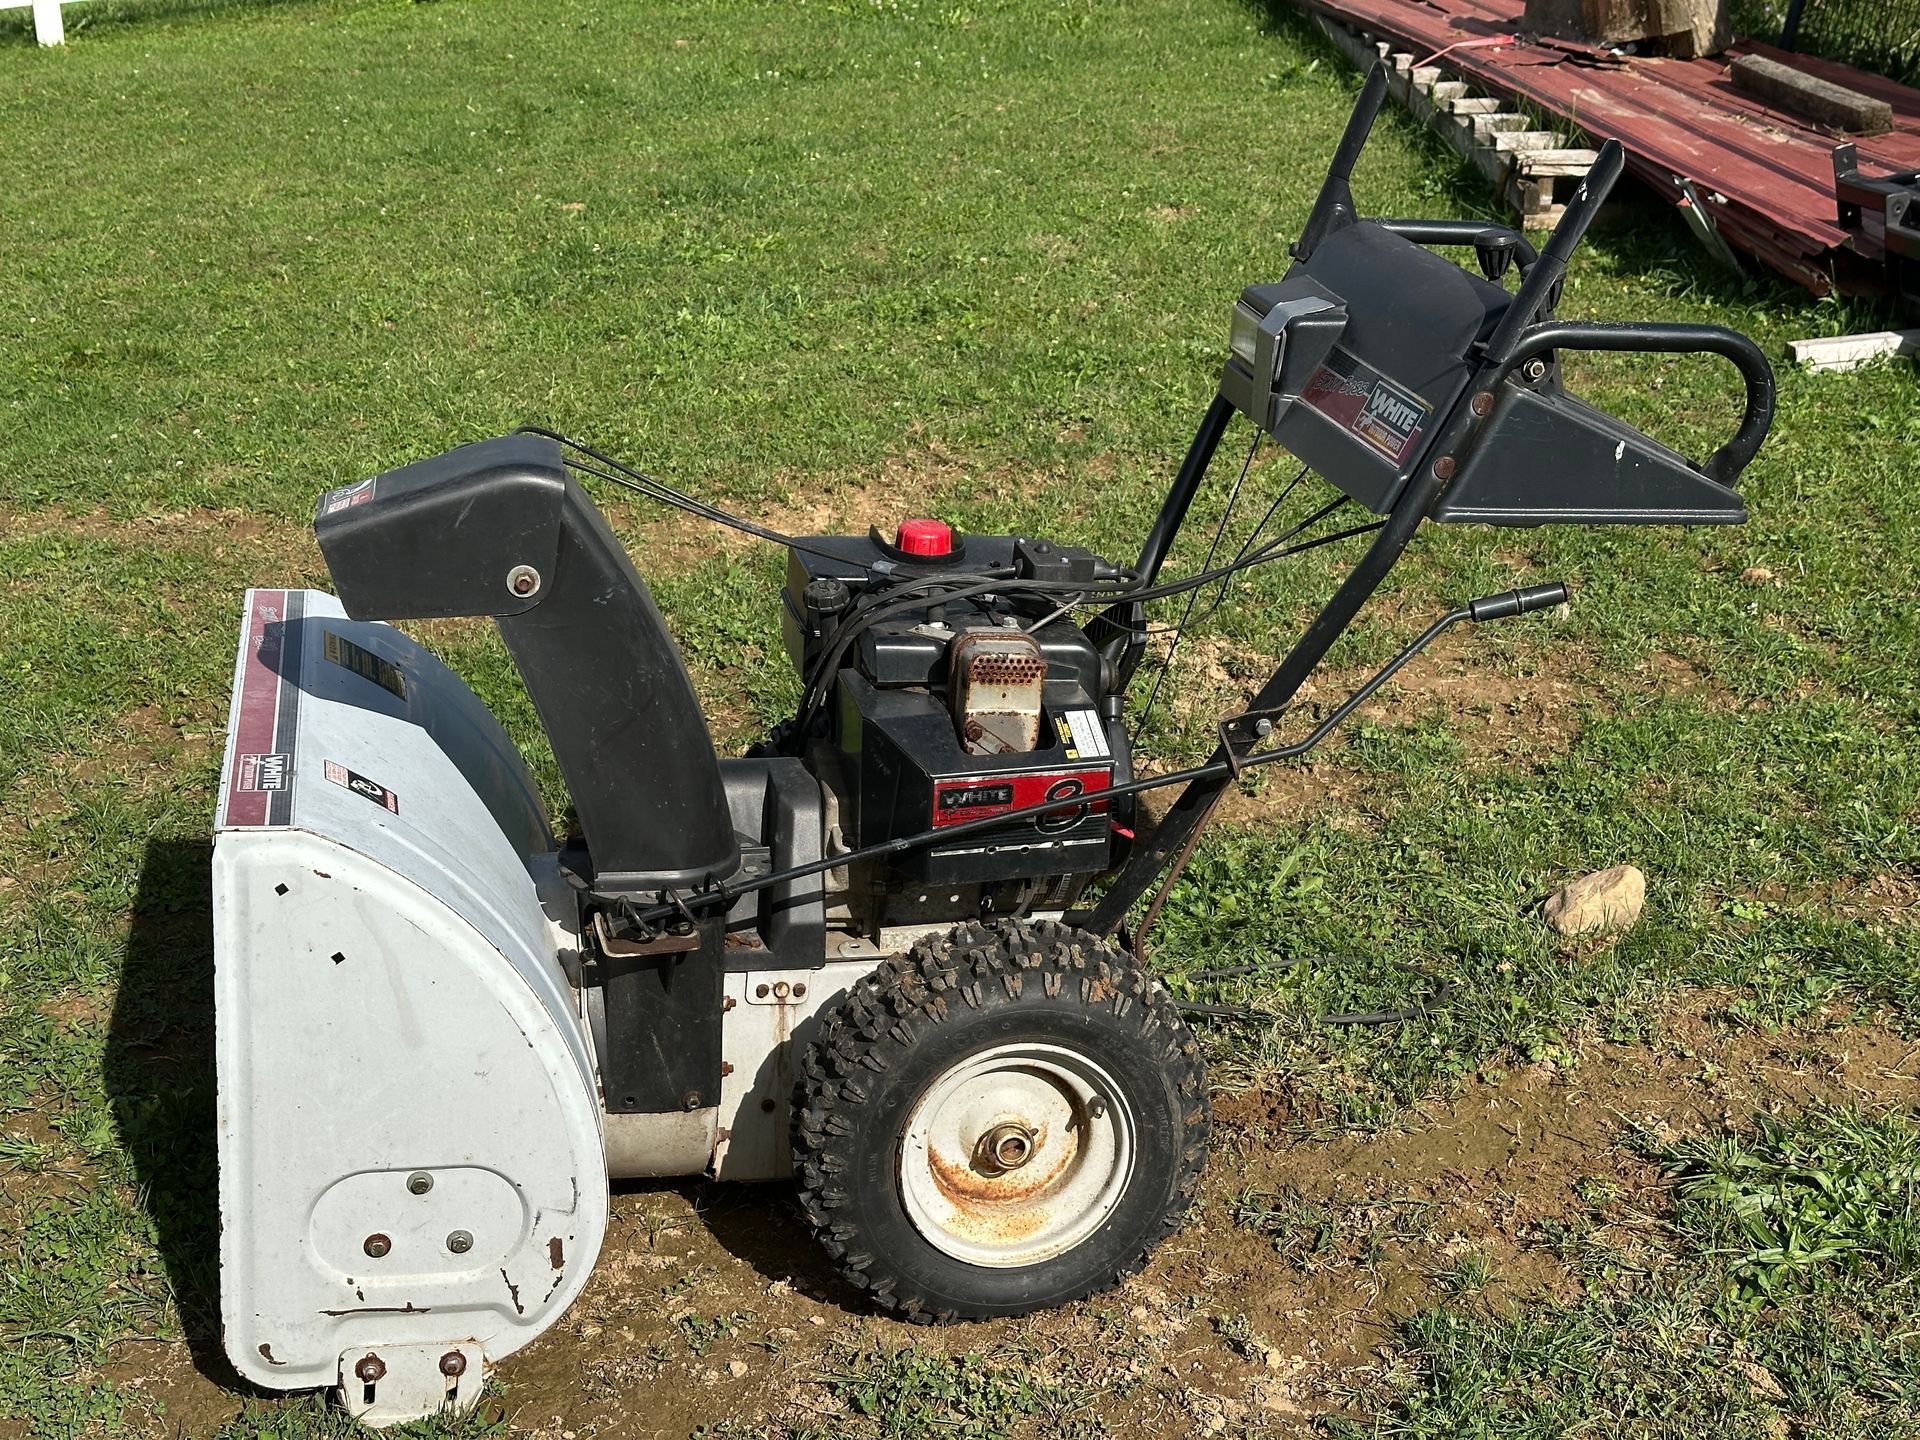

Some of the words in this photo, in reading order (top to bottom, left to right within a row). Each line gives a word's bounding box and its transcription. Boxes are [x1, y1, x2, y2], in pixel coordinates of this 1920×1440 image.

[1370, 389, 1419, 431] WHITE
[262, 755, 284, 790] WHITE
[943, 788, 1008, 806] WHITE
[1034, 778, 1090, 835] 8
